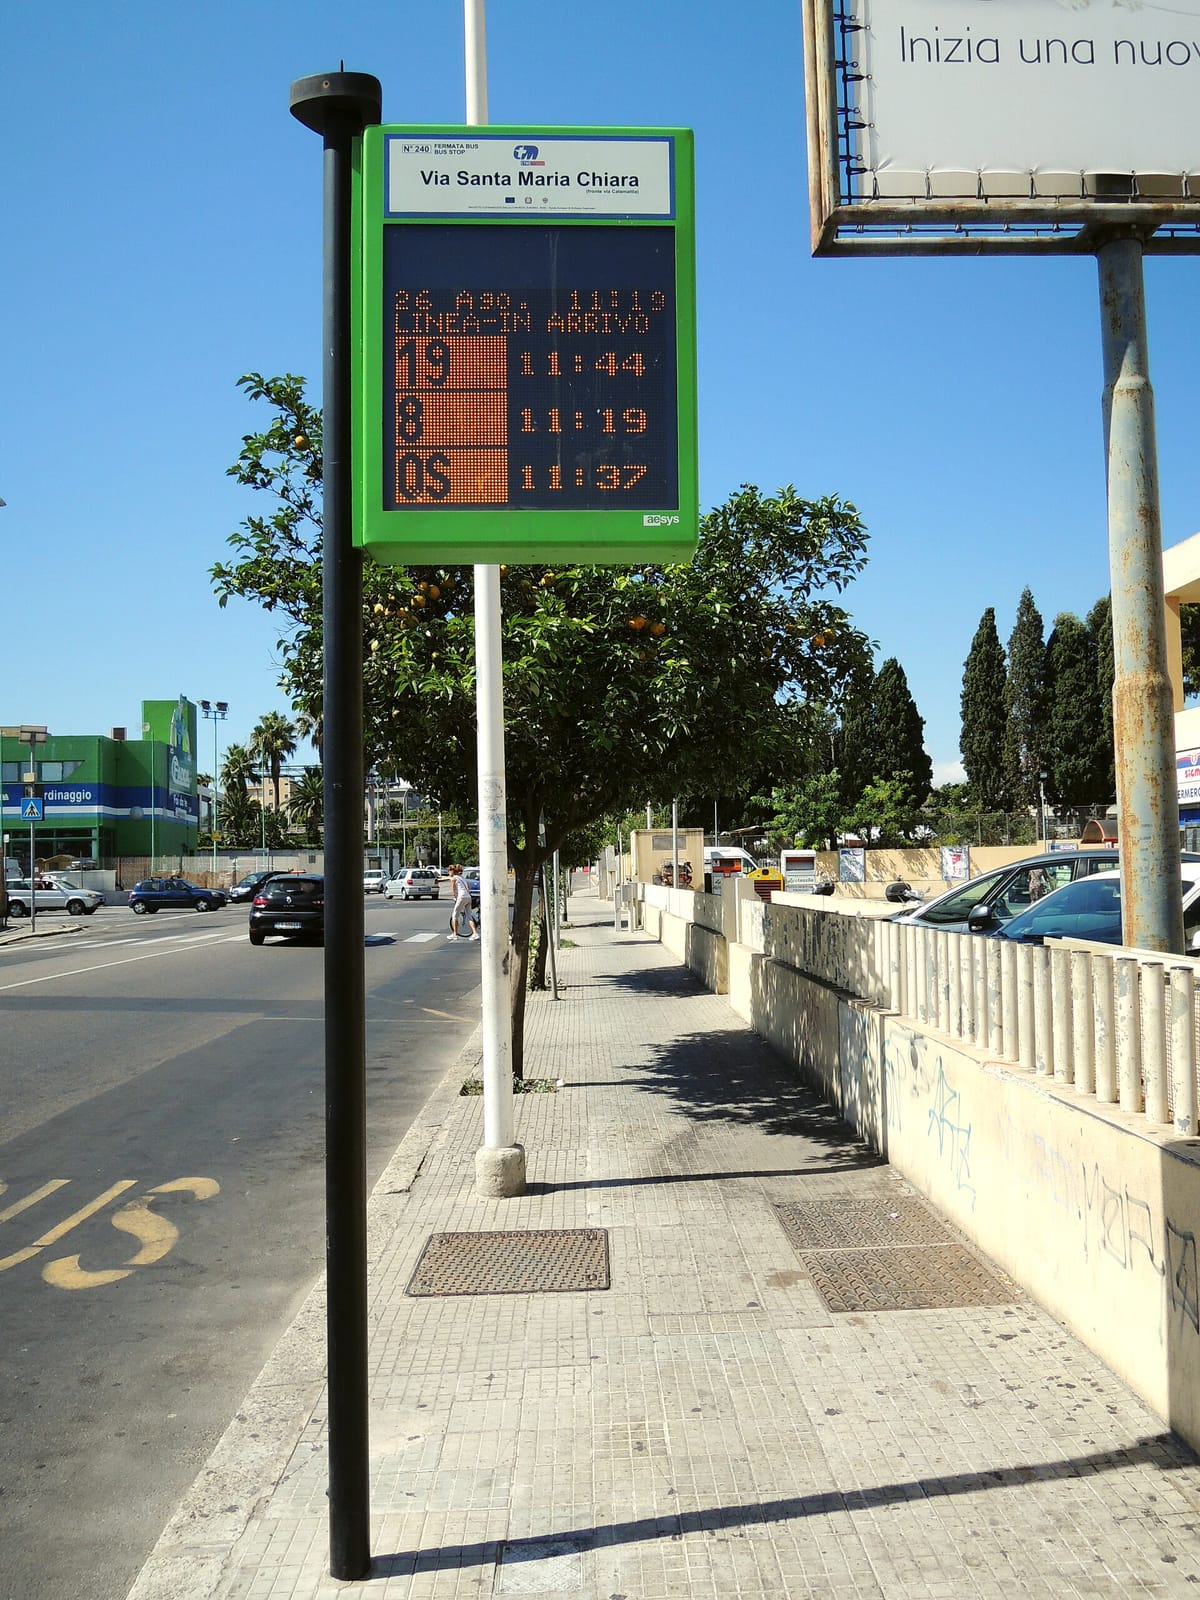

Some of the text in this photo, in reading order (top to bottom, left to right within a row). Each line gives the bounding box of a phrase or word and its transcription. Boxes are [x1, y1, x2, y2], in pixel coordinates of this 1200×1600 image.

[900, 26, 999, 63] Inizia
[1018, 38, 1095, 64] una
[415, 145, 430, 153] 240
[420, 170, 639, 187] Via Santa Maria Chiara
[395, 289, 433, 311] 26
[570, 289, 666, 312] 11:19
[547, 311, 650, 334] ARRIVO
[399, 339, 647, 387] 19 11:44
[399, 396, 648, 443] 8 11:19
[520, 464, 648, 490] 11:37
[645, 514, 681, 527] aesys
[43, 789, 92, 803] rdinaggio
